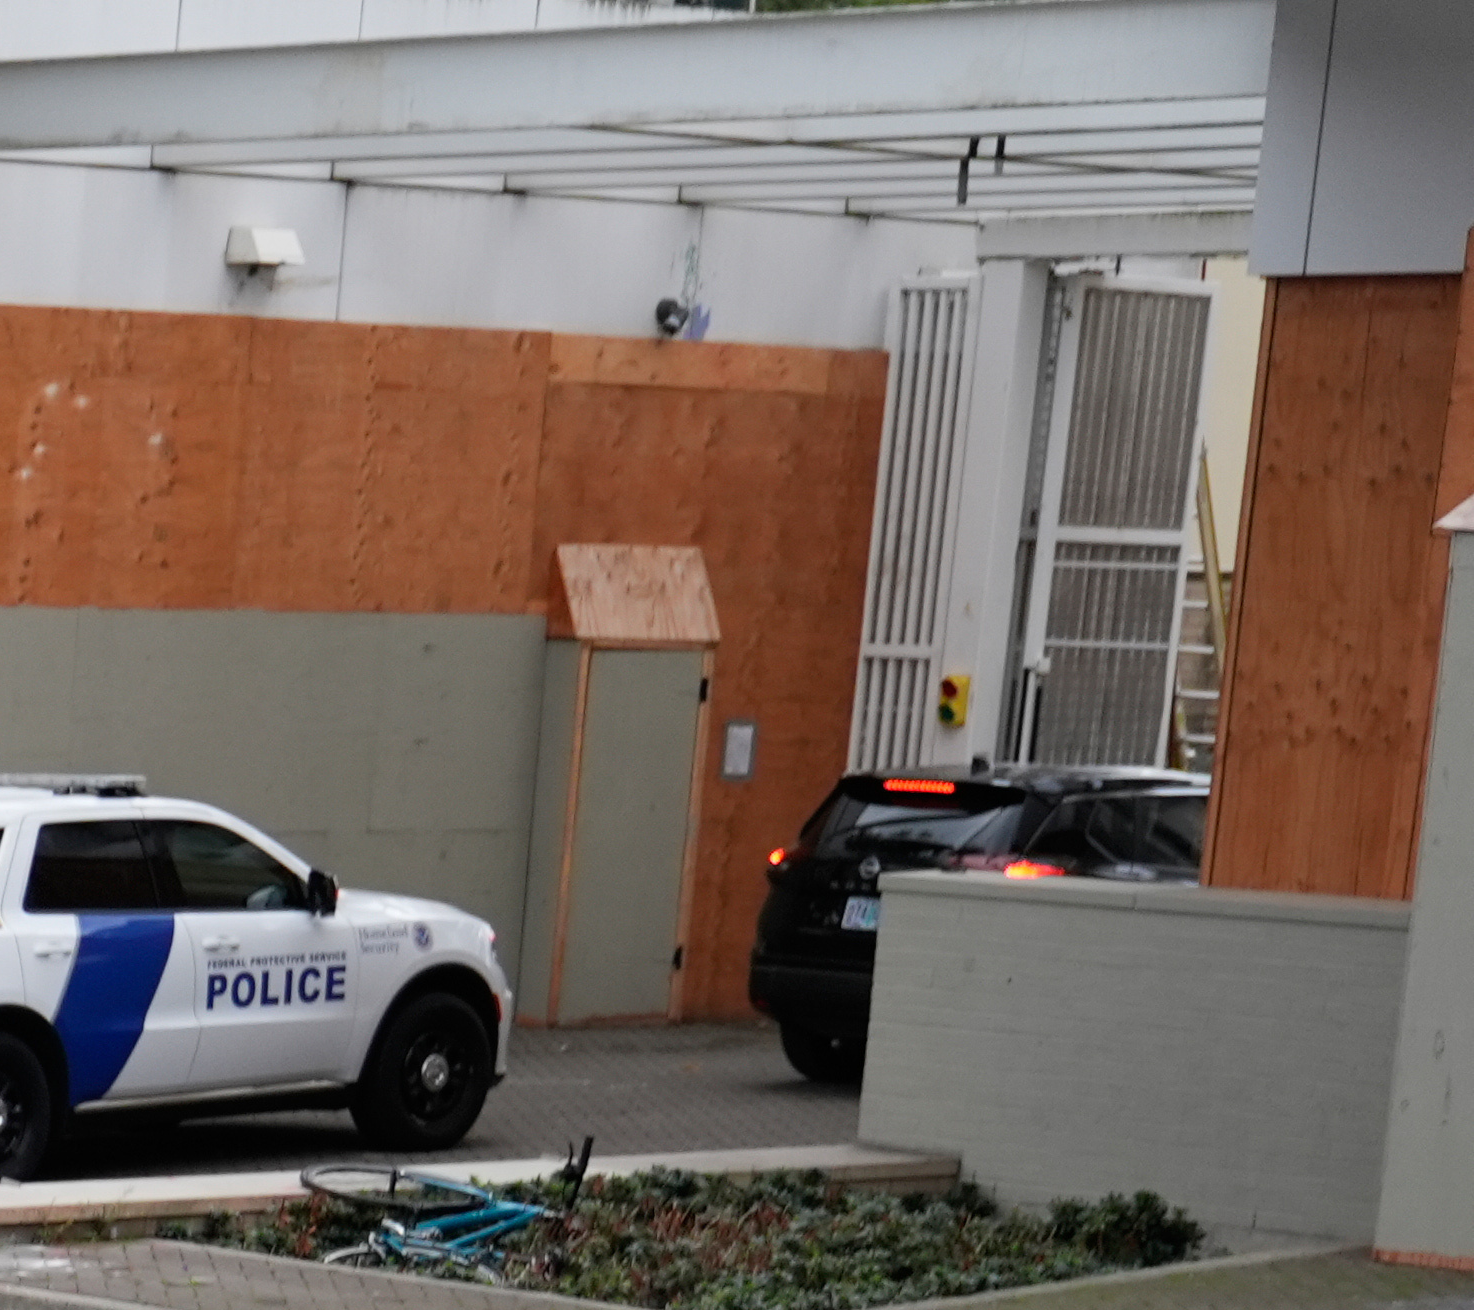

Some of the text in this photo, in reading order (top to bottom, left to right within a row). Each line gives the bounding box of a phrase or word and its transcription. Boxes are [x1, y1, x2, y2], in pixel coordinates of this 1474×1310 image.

[207, 951, 347, 970] FEDERAL PROTECTIVE SERVICE
[206, 965, 347, 1011] POLICE
